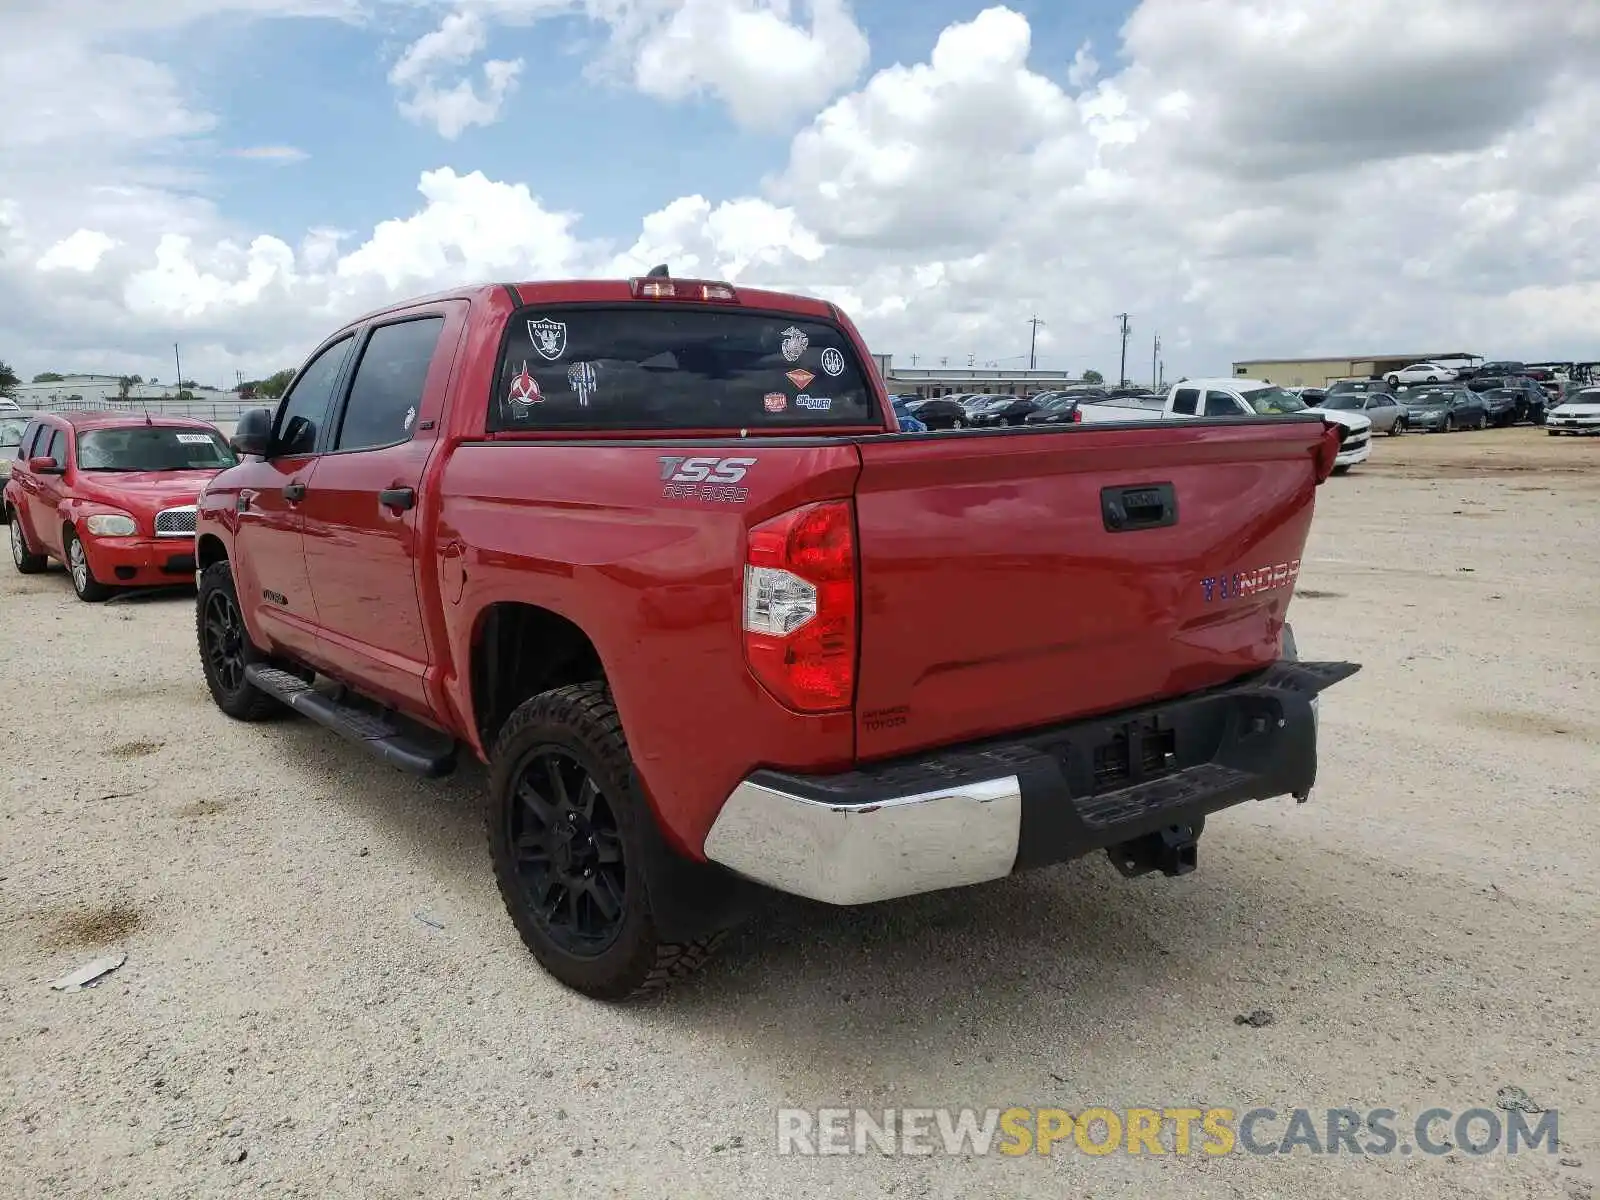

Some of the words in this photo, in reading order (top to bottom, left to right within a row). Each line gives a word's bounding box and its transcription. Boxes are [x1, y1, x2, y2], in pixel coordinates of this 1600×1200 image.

[797, 395, 809, 405] SIG
[807, 398, 831, 410] SAUER
[657, 456, 757, 483] TSS
